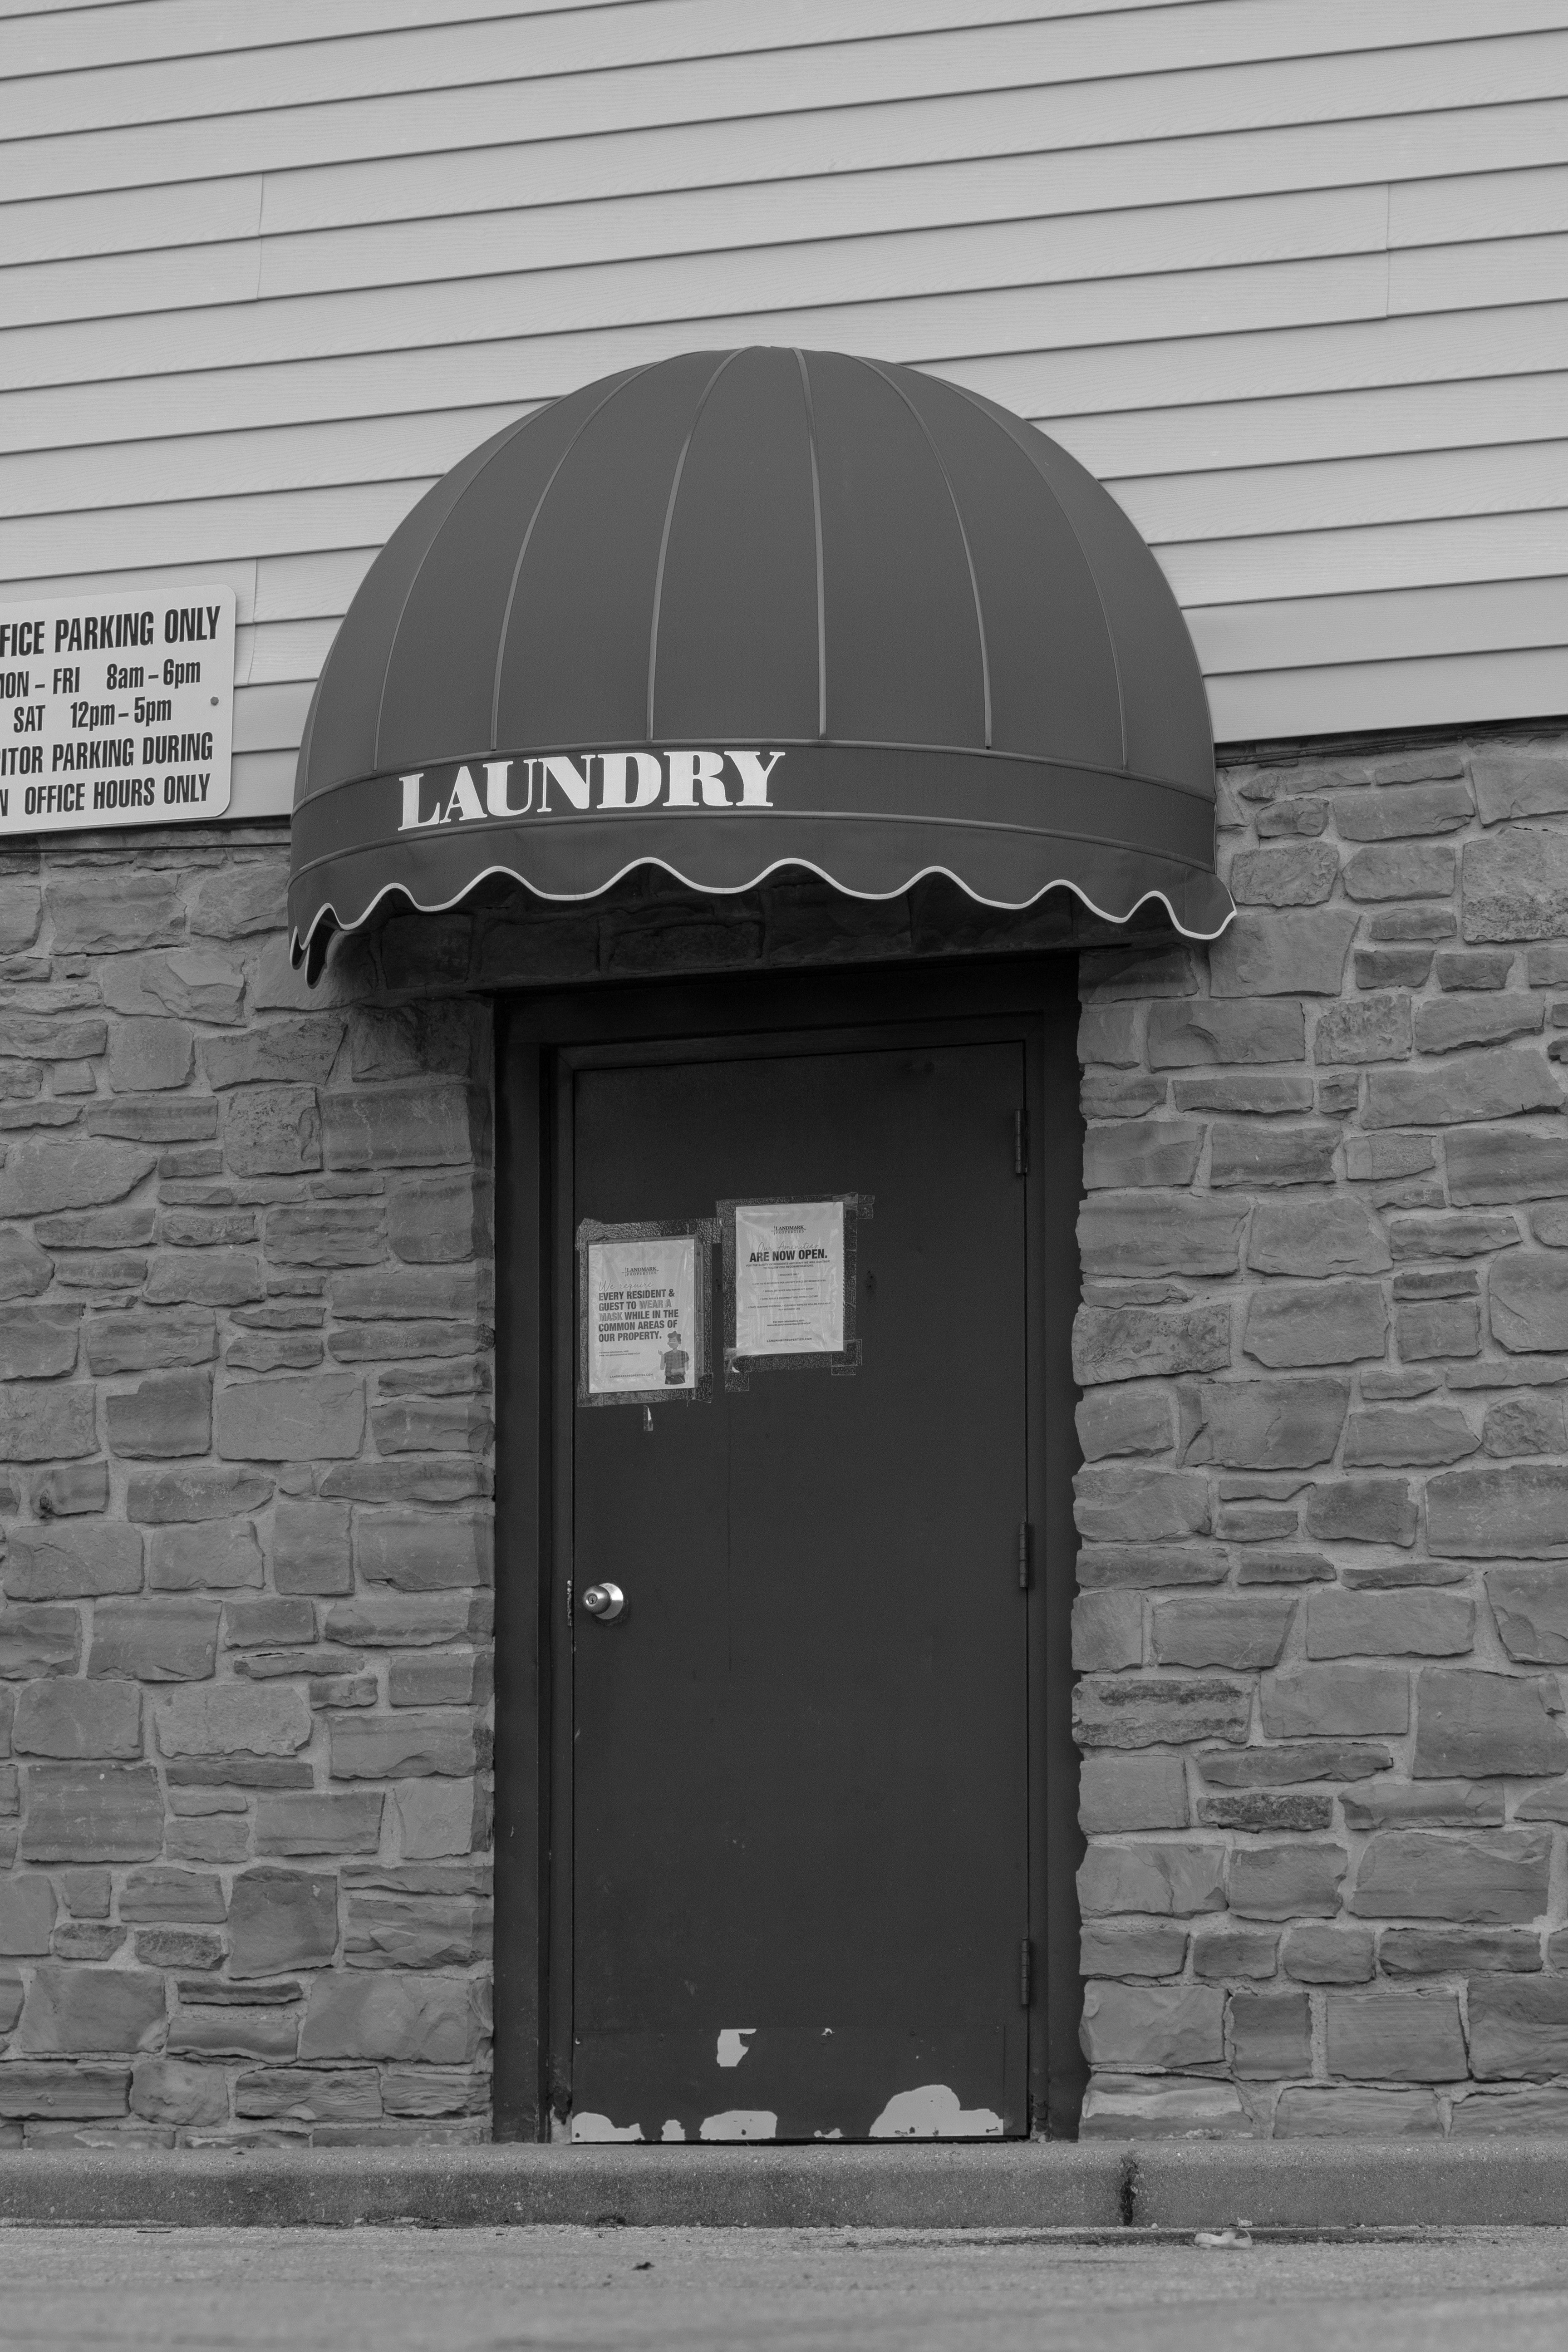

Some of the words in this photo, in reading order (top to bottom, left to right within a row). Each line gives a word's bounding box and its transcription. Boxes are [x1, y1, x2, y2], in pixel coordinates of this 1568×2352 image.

[55, 611, 154, 653] PARKING
[165, 605, 221, 644] ONLY
[53, 667, 80, 694] FRI
[14, 705, 45, 733] SAT
[52, 738, 134, 772] PARKING
[143, 732, 213, 765] DURING
[25, 782, 85, 815] OFFICE
[93, 777, 155, 810] HOURS
[164, 773, 211, 804] ONLY
[398, 751, 786, 831] LAUNDRY
[758, 1242, 773, 1252] Our
[777, 1240, 820, 1251] Amenities
[749, 1252, 769, 1262] ARE
[772, 1250, 796, 1261] NOW
[799, 1249, 827, 1260] OPEN.
[599, 1278, 615, 1292] We
[619, 1282, 654, 1293] require
[599, 1291, 624, 1301] EVERY
[626, 1289, 666, 1299] RESIDENT
[668, 1289, 675, 1297] &
[599, 1302, 624, 1311] GUEST
[626, 1301, 636, 1309] TO
[639, 1299, 664, 1309] WEAR
[665, 1299, 672, 1308] A
[599, 1312, 623, 1322] MASK
[624, 1311, 649, 1320] WHILE
[652, 1310, 660, 1319] IN
[664, 1309, 679, 1318] THE
[599, 1322, 635, 1332] COMMON
[638, 1320, 664, 1329] AREAS
[667, 1319, 678, 1328] OF
[599, 1333, 615, 1342] OUR
[618, 1331, 662, 1341] PROPERTY.
